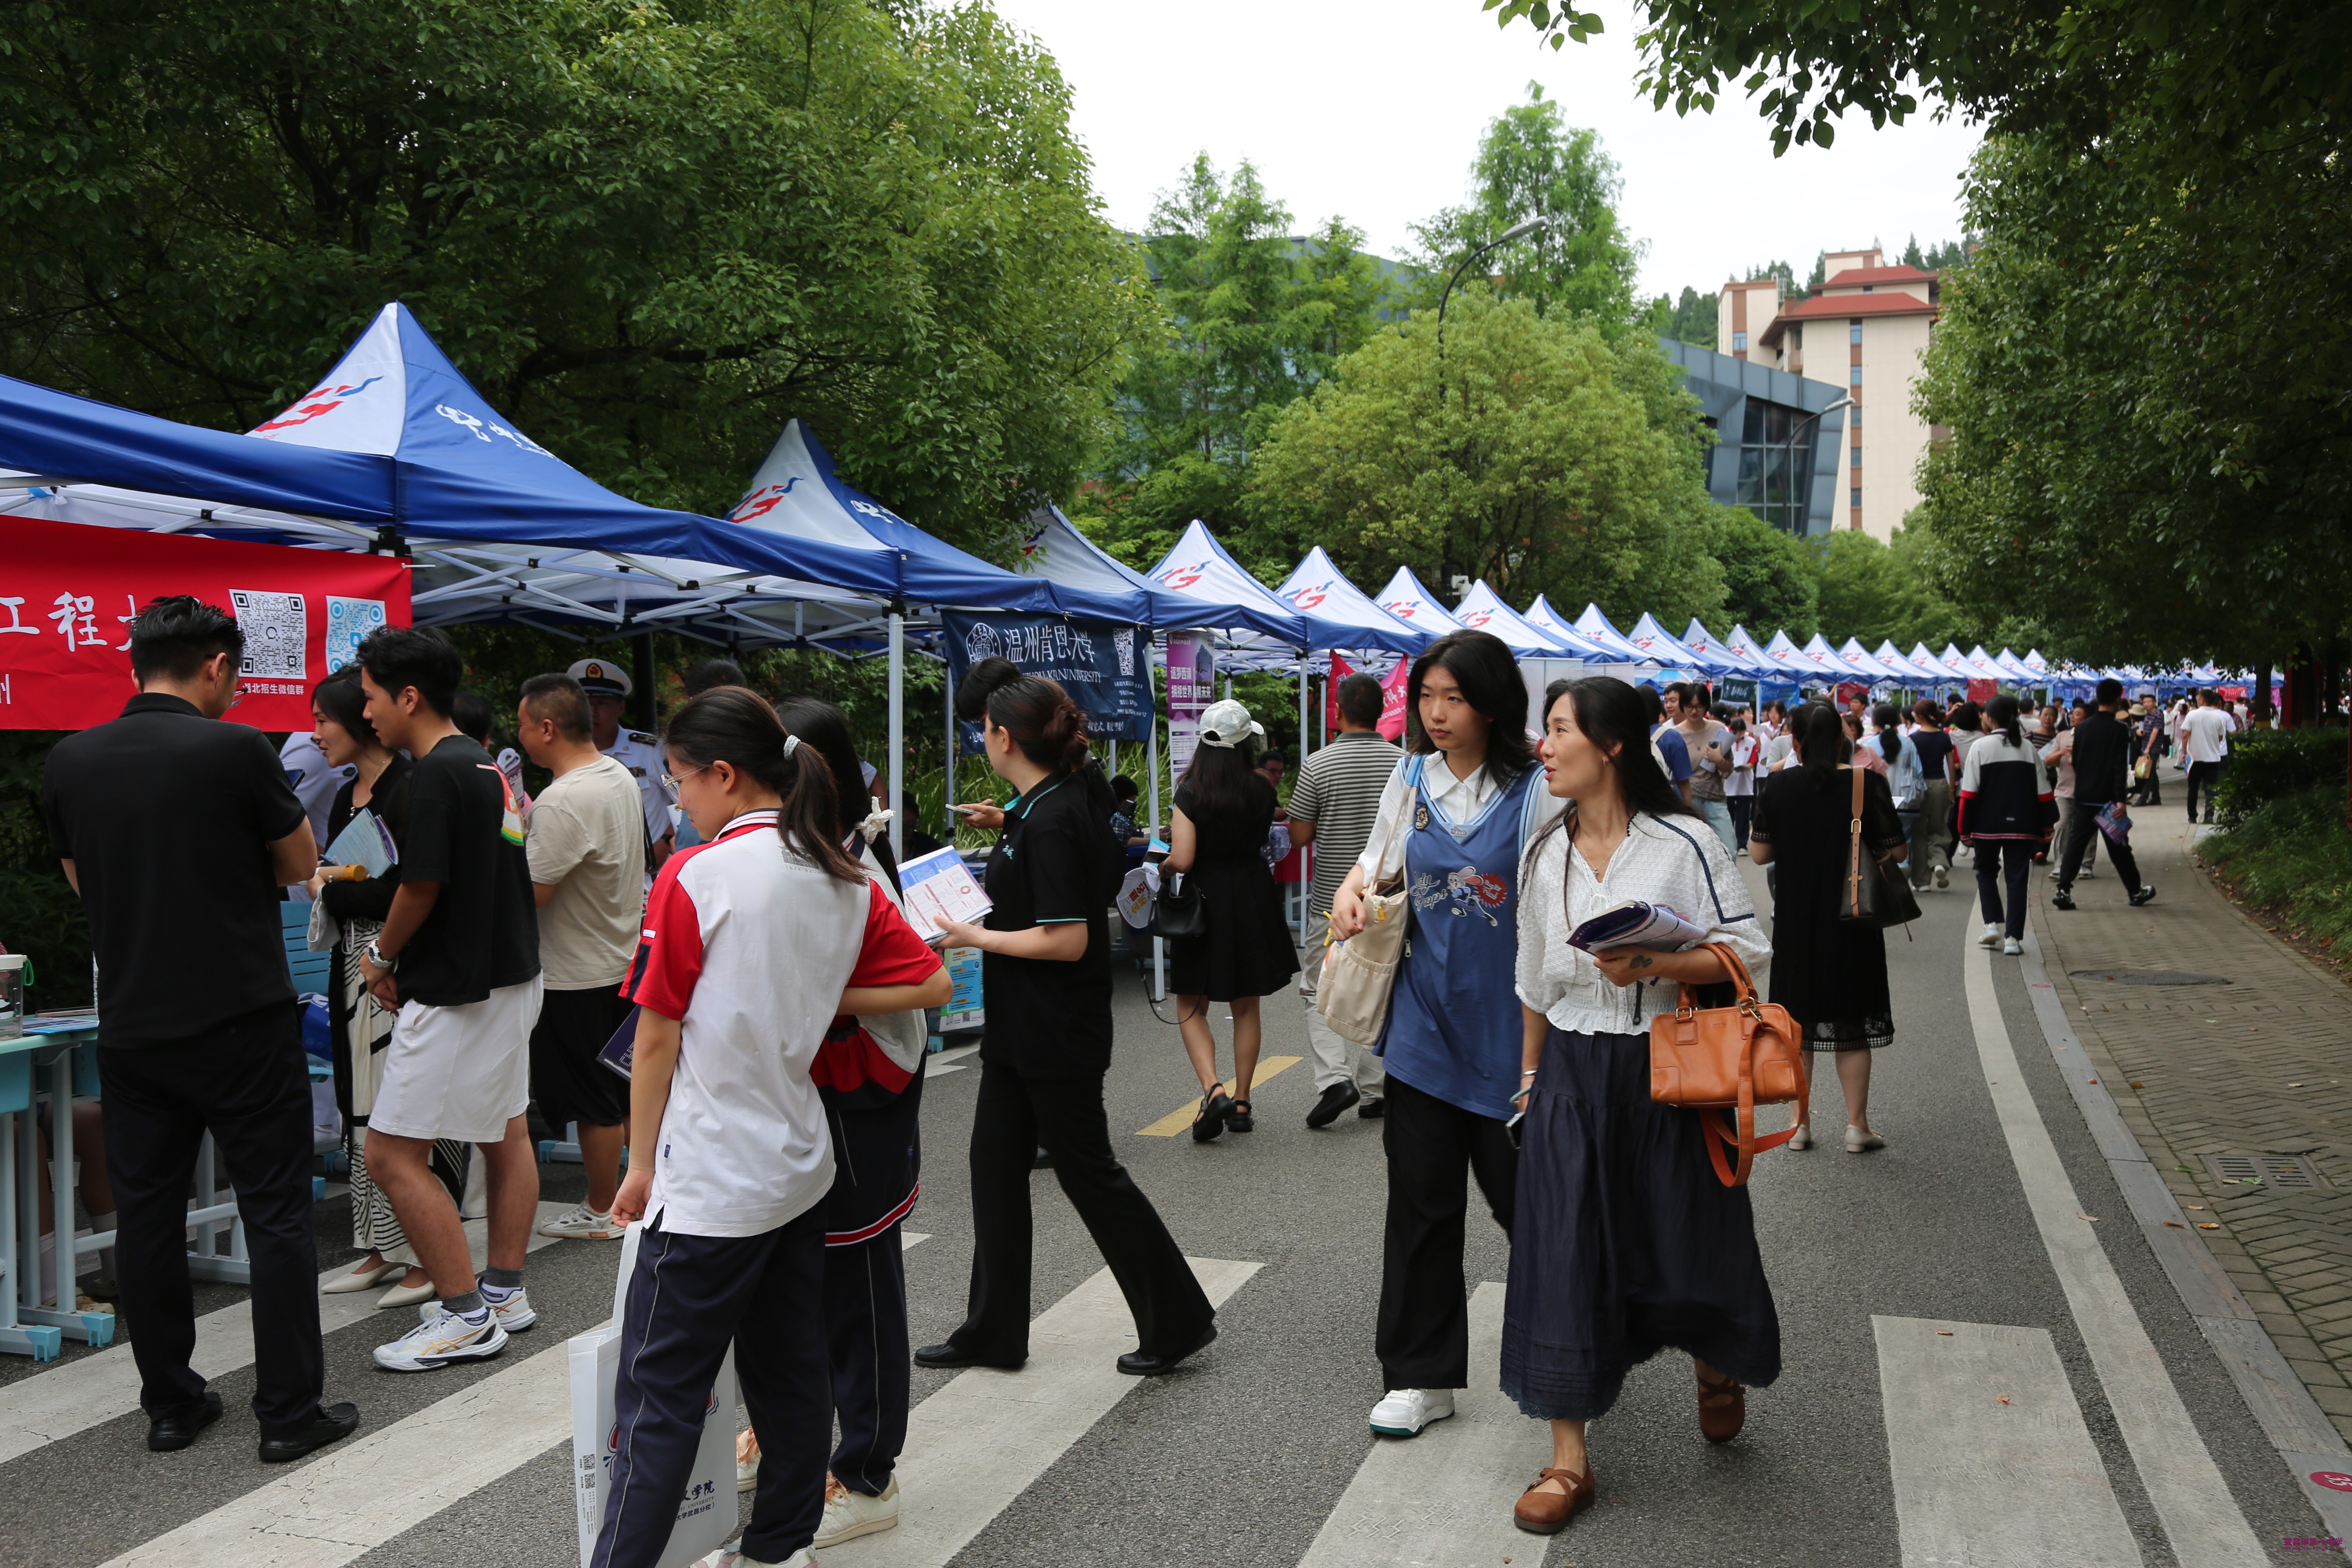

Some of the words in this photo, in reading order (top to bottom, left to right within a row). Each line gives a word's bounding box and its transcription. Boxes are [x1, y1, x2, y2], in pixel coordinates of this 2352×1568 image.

[972, 625, 994, 639] KEAN
[1003, 624, 1095, 663] 温州肯恩大学
[243, 683, 304, 695] 湖北招生微信群
[688, 1496, 714, 1508] UNIVERSITY
